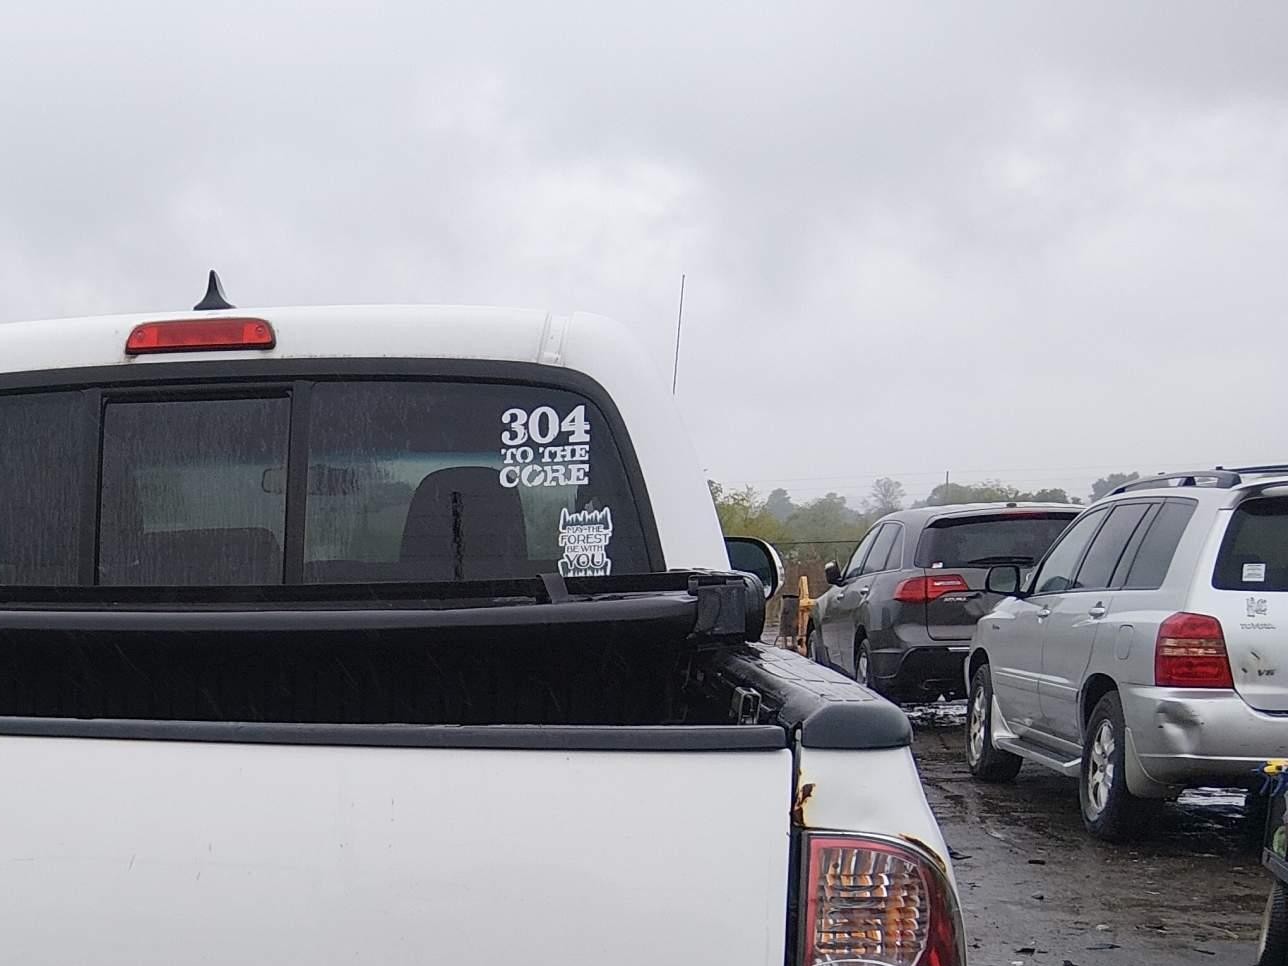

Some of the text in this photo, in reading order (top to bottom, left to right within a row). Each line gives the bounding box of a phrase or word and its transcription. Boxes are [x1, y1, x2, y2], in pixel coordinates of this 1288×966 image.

[501, 405, 591, 446] 304
[500, 444, 590, 464] TO THE
[499, 463, 590, 488] CORE
[560, 533, 609, 546] FOREST
[567, 544, 603, 553] BE WITH
[564, 553, 605, 569] YOU
